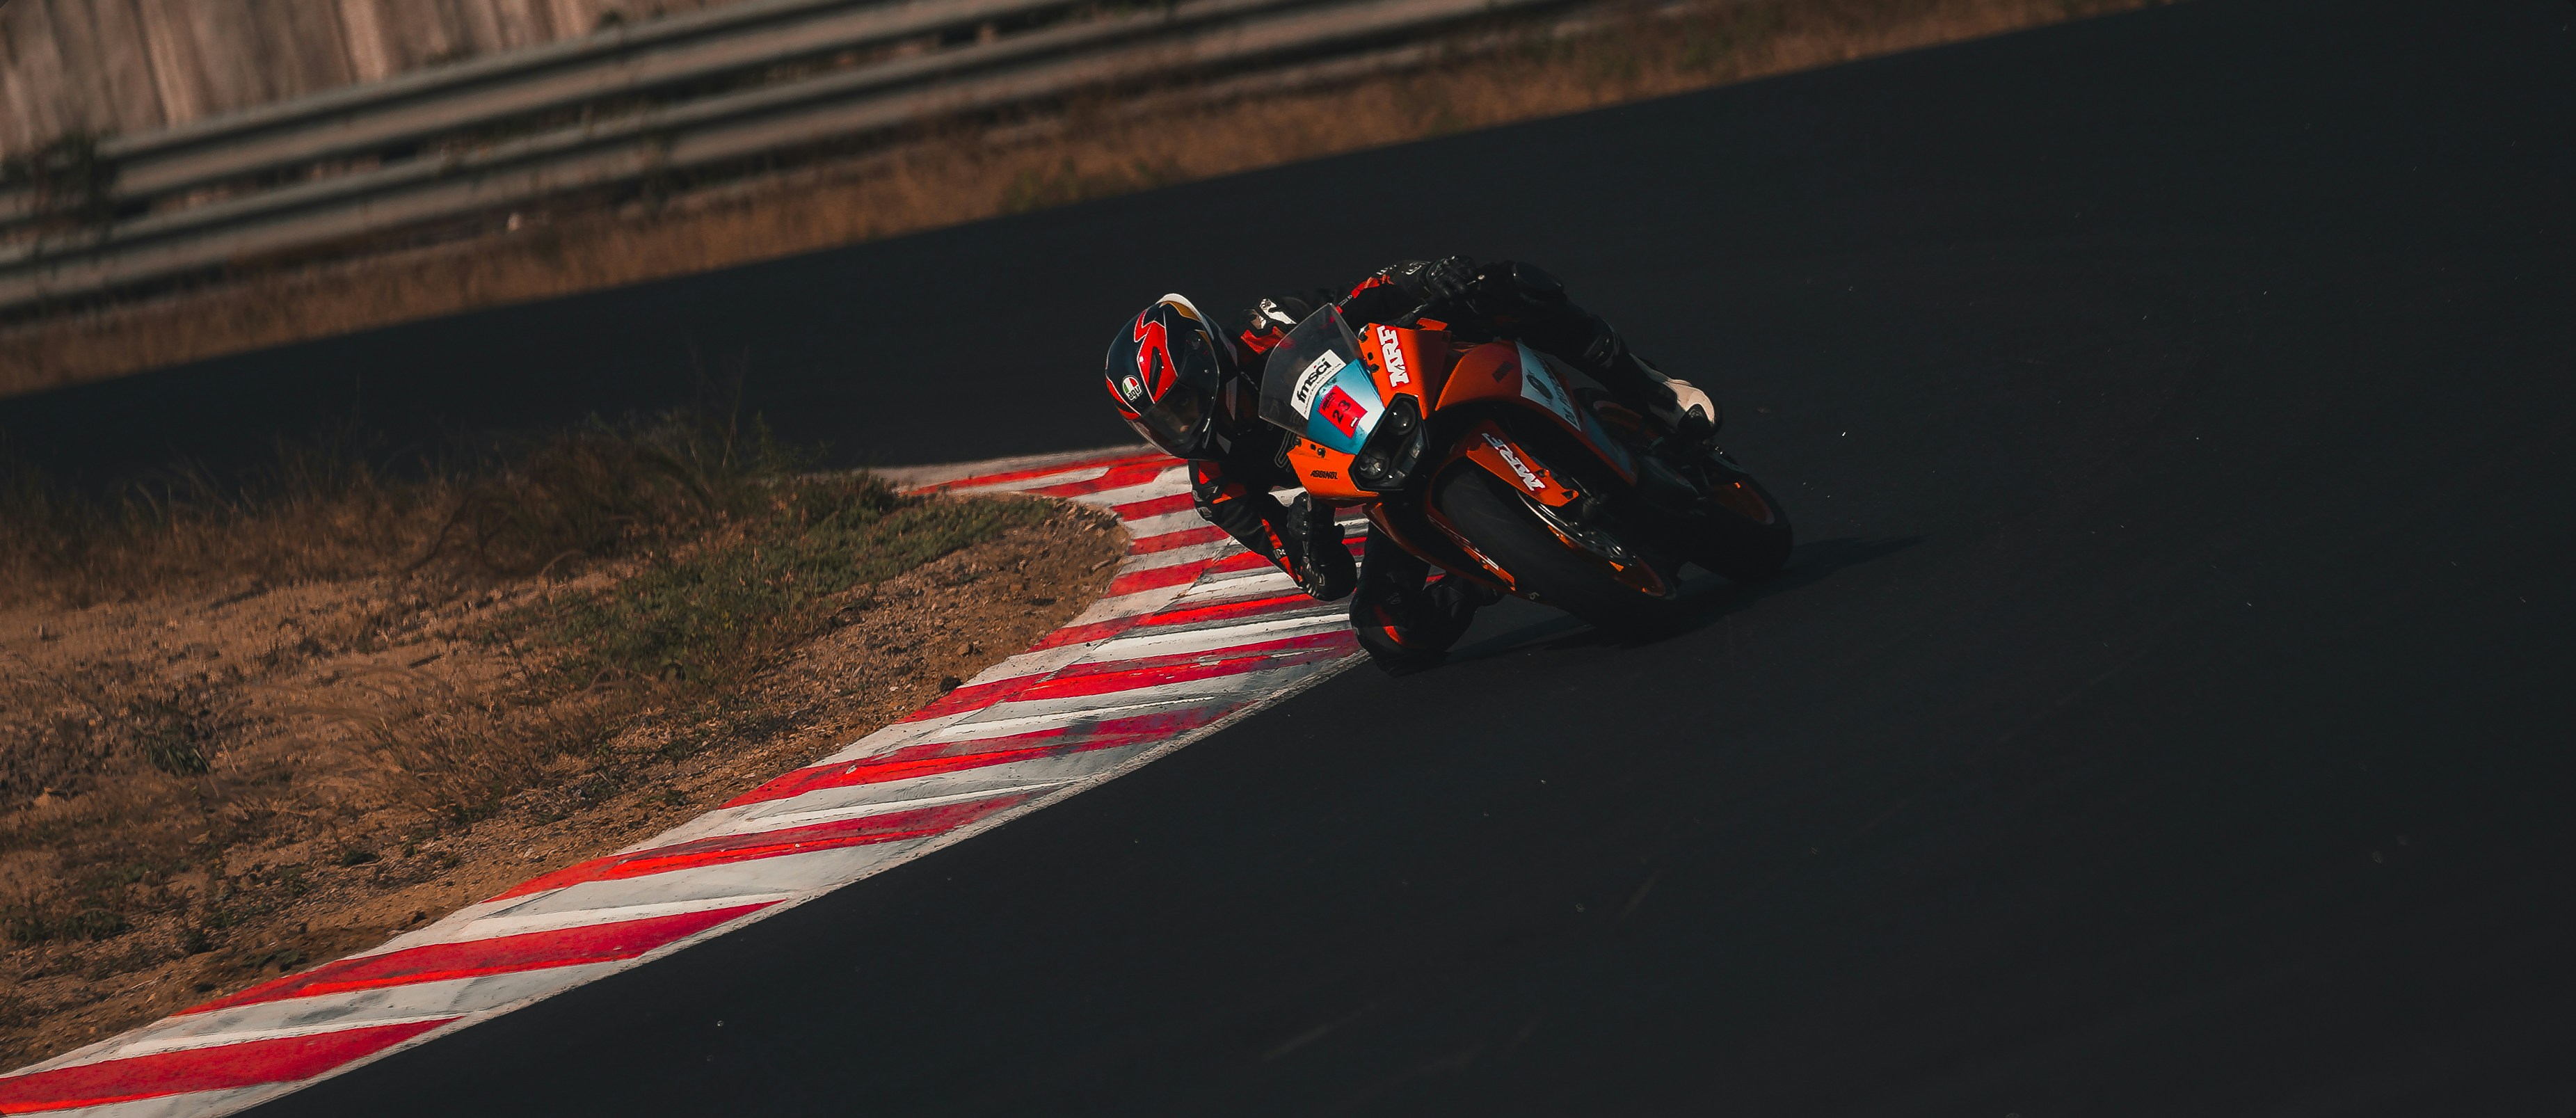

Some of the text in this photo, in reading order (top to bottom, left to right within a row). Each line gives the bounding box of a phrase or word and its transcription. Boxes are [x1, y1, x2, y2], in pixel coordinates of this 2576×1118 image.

[1377, 326, 1409, 387] MRF
[1128, 385, 1141, 399] AGV
[1297, 358, 1331, 404] fmsci
[1332, 399, 1351, 424] 23
[1482, 433, 1545, 491] MRF
